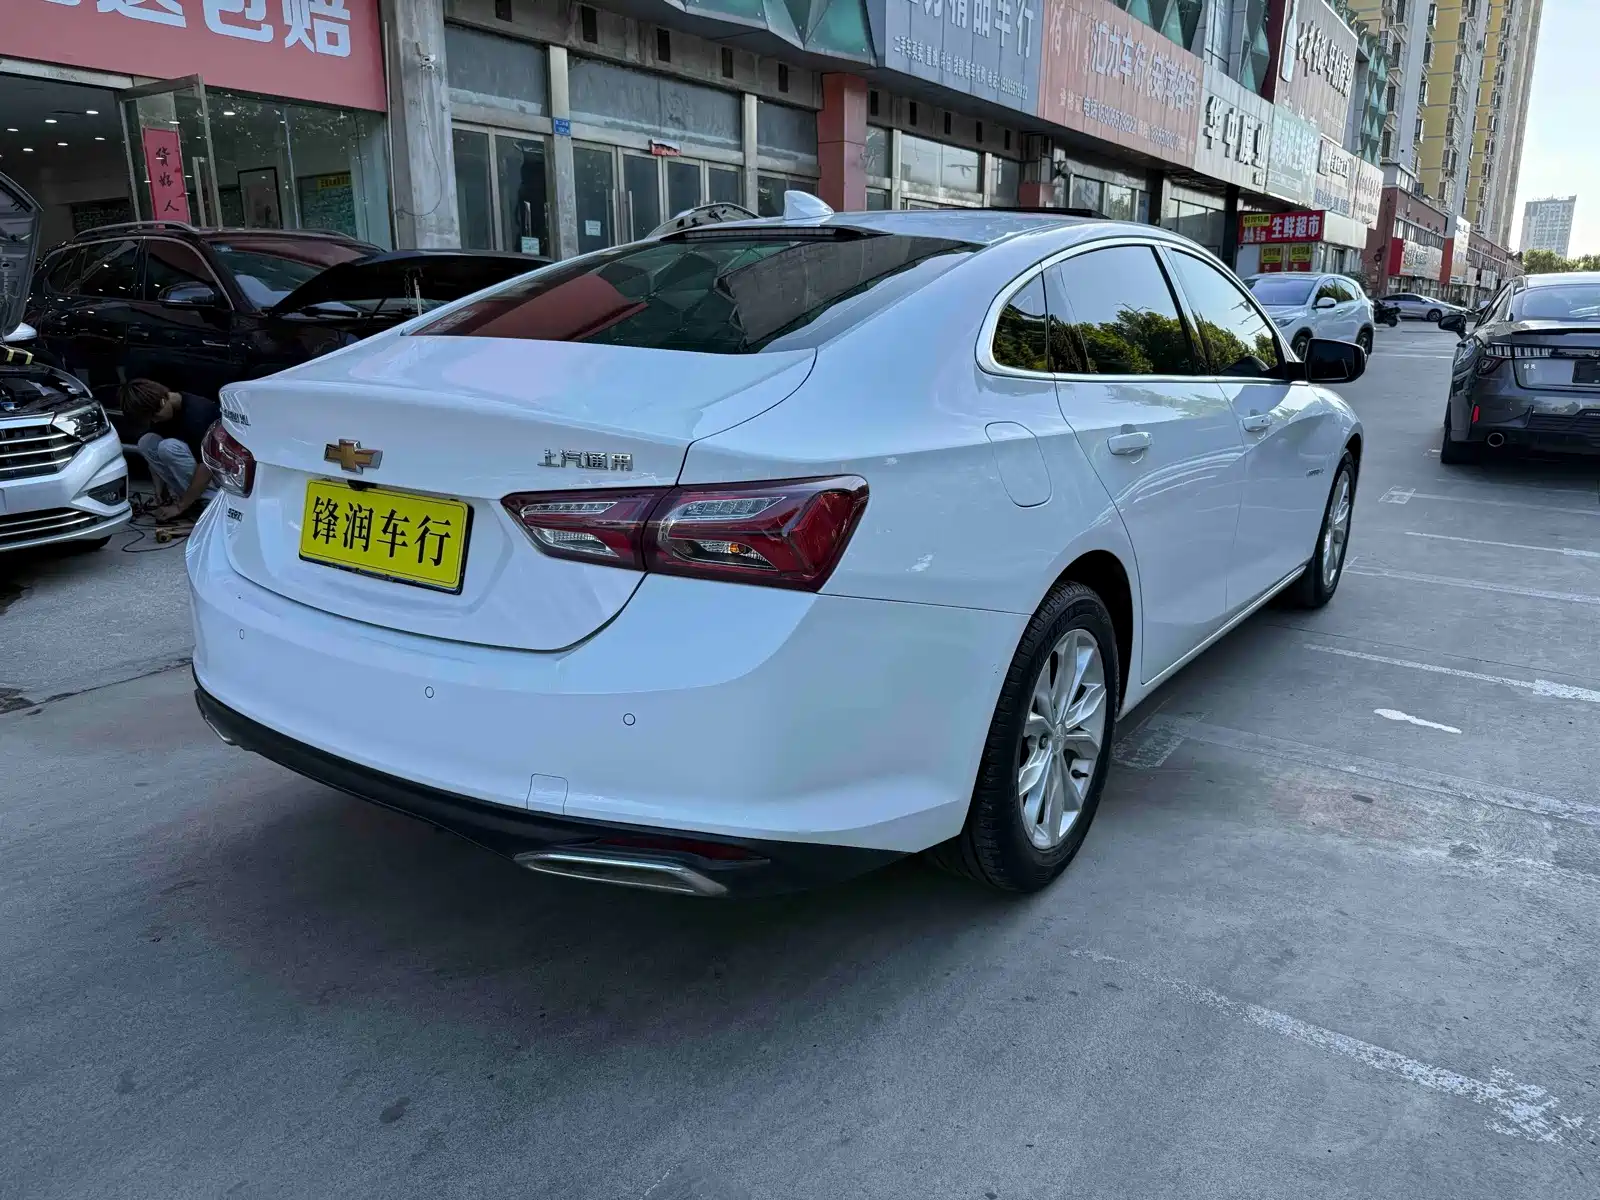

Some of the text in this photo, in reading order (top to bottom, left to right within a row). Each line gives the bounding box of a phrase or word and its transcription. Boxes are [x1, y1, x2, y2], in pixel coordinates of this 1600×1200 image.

[1271, 215, 1320, 239] 生鲜超市
[537, 448, 634, 472] 上汽通用
[312, 495, 452, 567] 锋润车行
